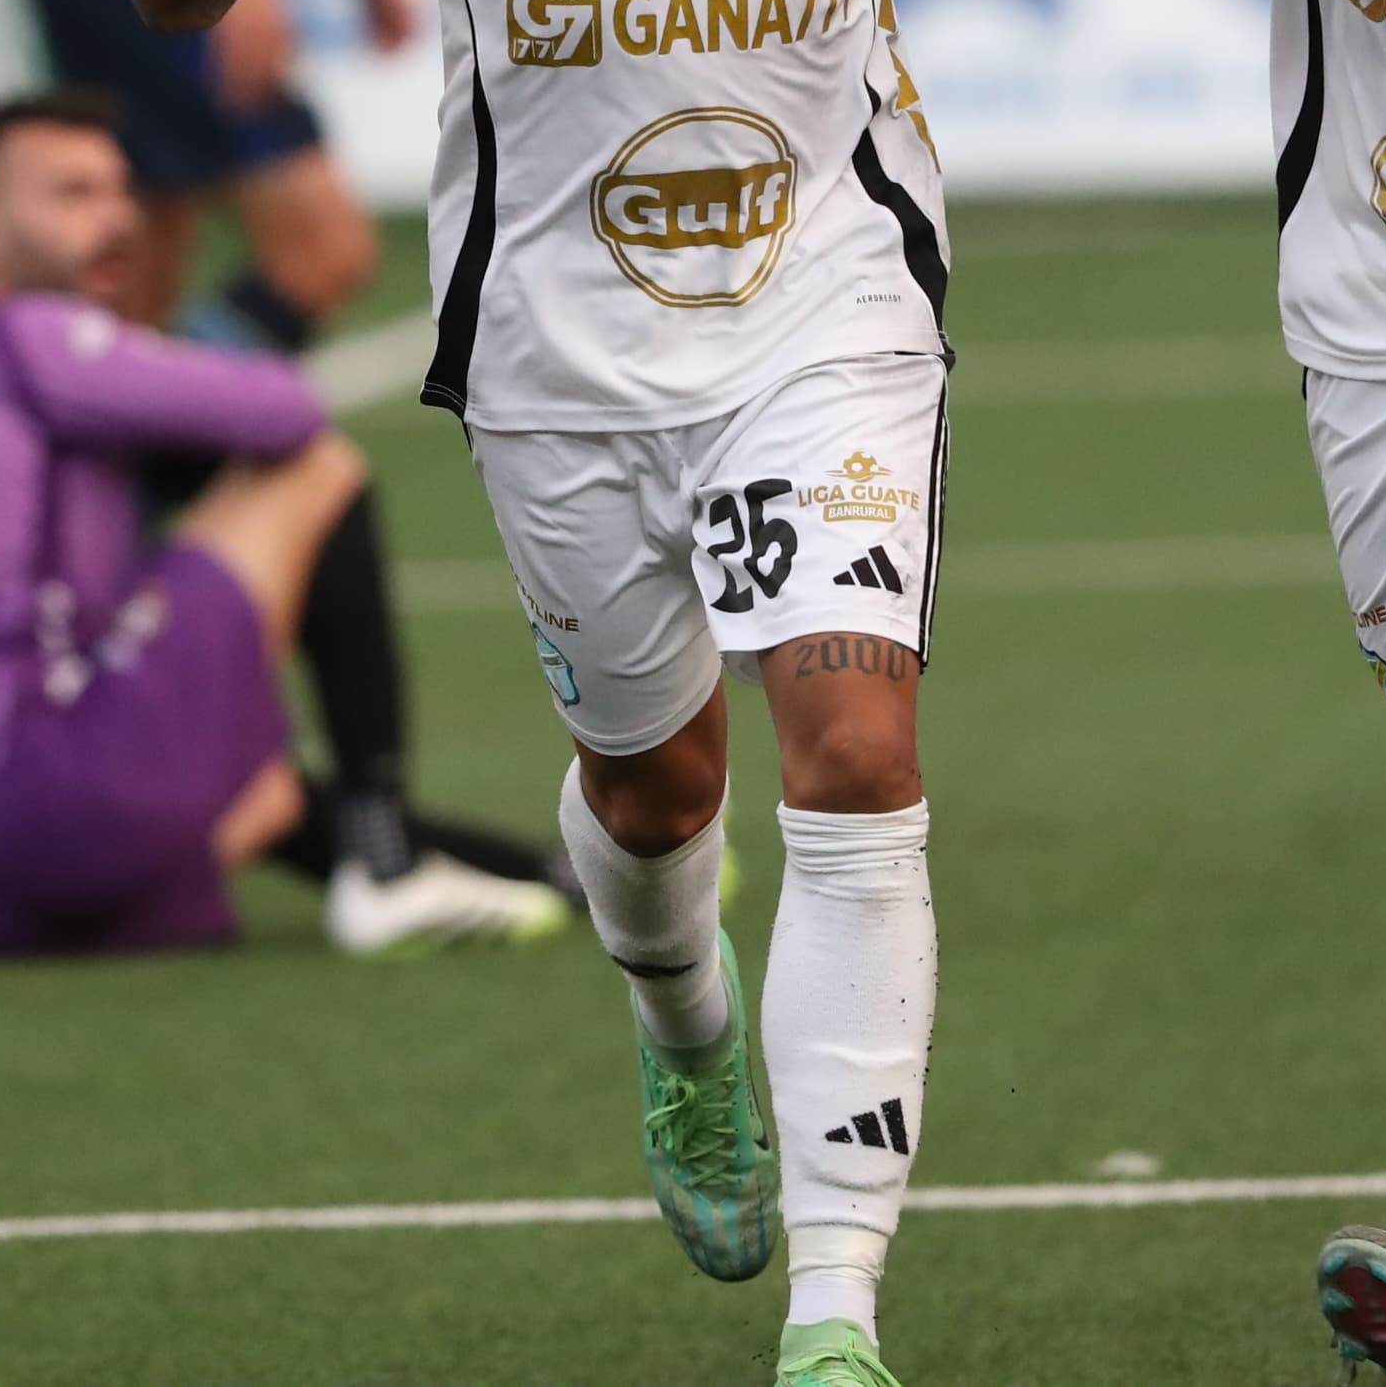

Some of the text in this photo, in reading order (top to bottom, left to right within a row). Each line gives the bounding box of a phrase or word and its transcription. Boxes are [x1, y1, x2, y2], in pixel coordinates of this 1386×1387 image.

[604, 171, 787, 236] Gulf
[797, 484, 920, 511] LIGA GUATE
[828, 505, 891, 519] BANRURAL
[706, 477, 798, 614] 26
[795, 635, 907, 681] 2000
